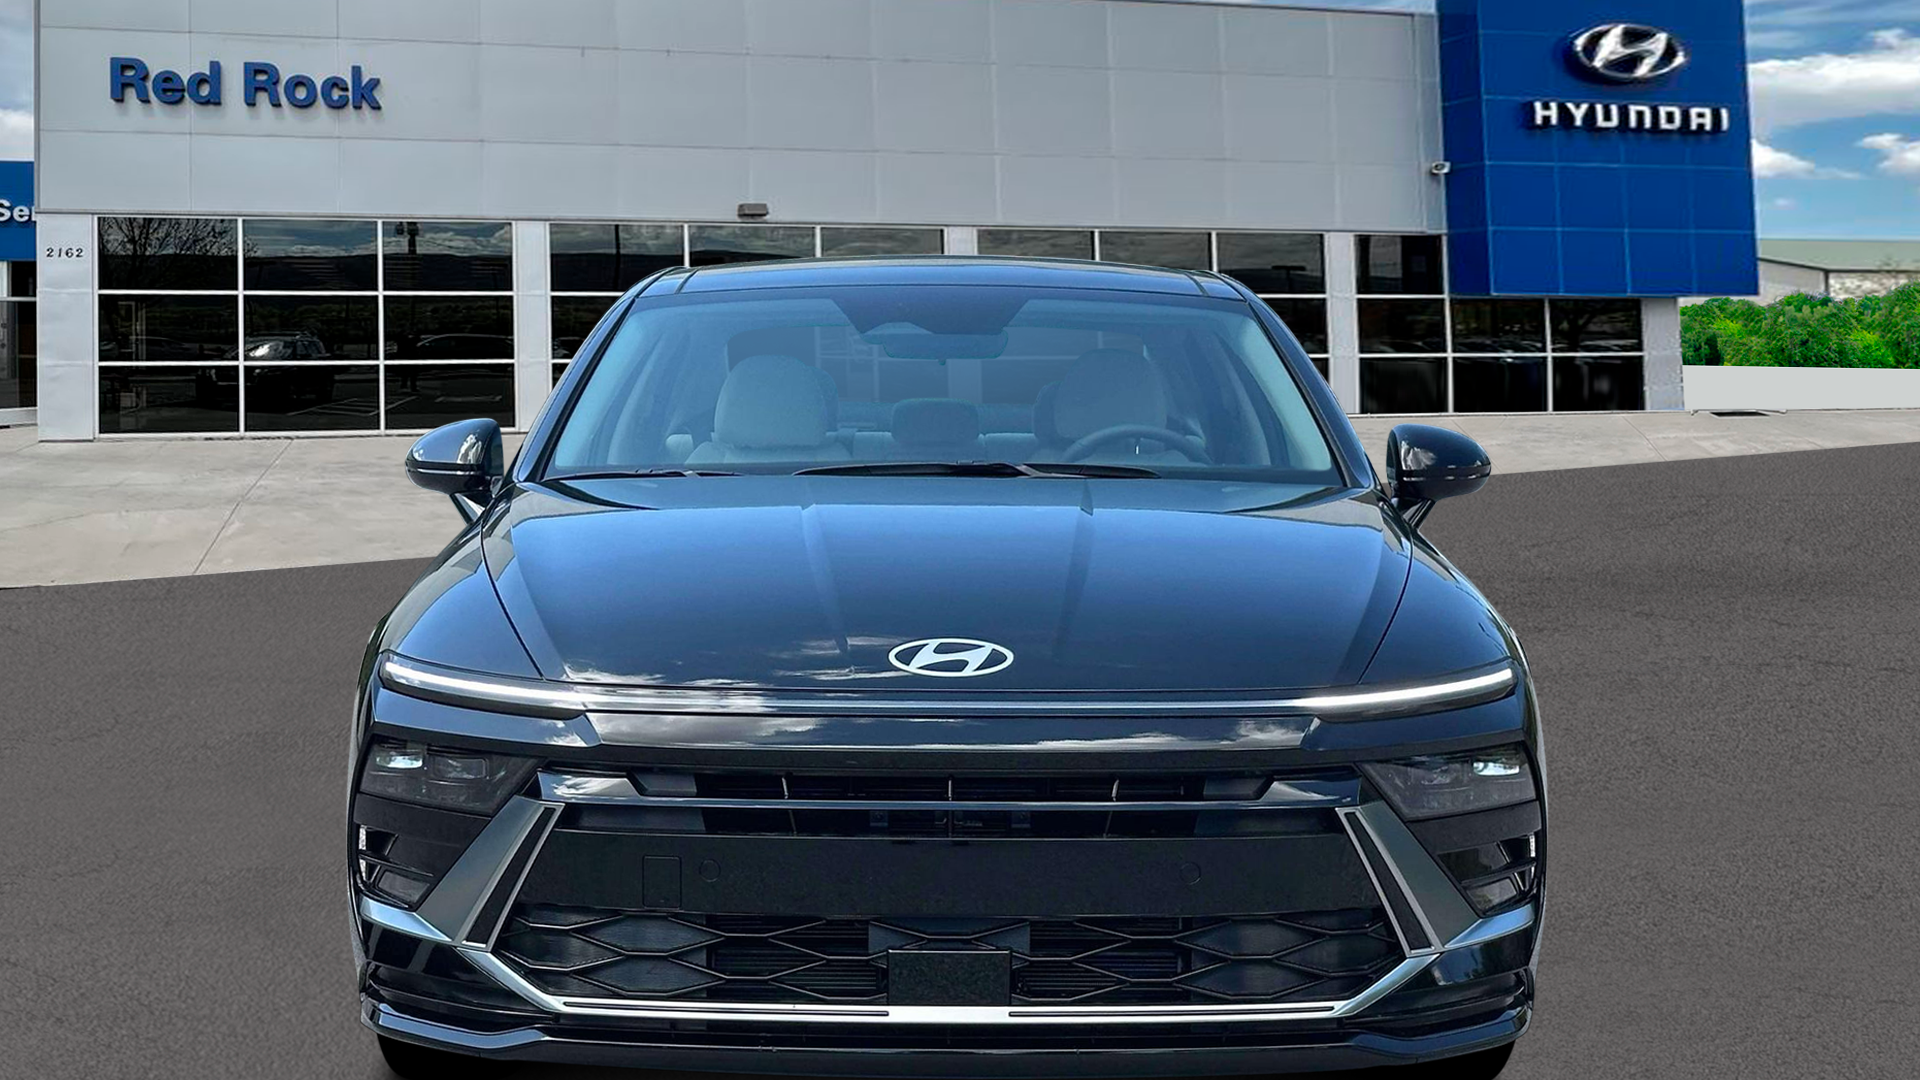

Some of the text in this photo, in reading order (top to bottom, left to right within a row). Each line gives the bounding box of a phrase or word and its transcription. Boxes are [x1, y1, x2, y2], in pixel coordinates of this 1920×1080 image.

[110, 56, 382, 110] Red Rock
[1533, 100, 1730, 132] HYUNDAI
[46, 246, 84, 259] 2162
